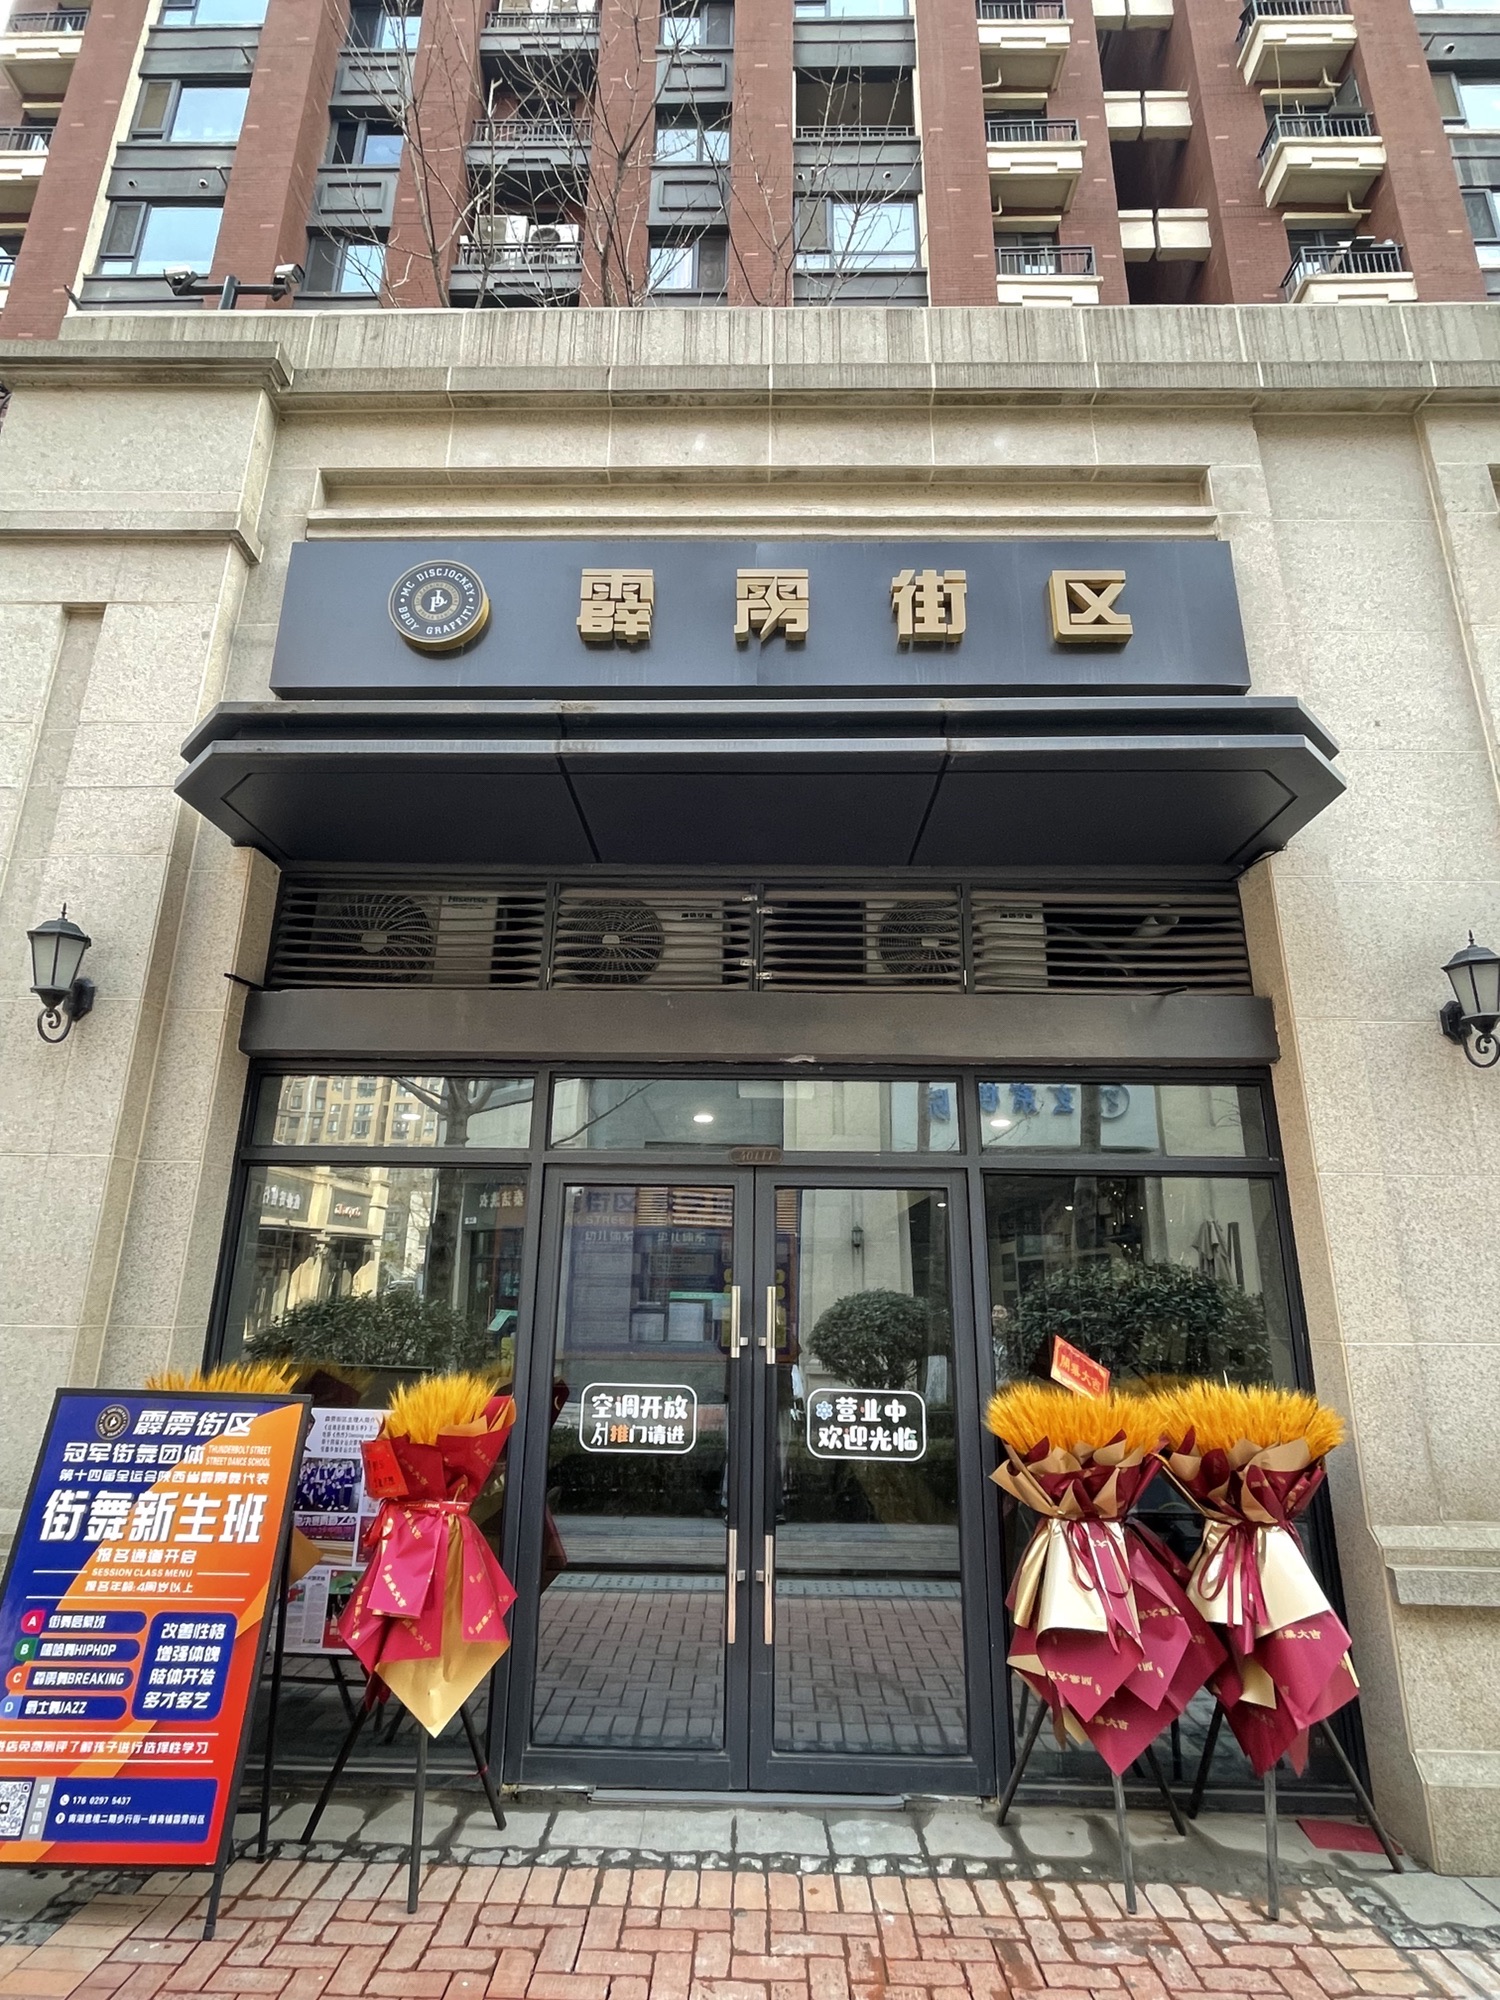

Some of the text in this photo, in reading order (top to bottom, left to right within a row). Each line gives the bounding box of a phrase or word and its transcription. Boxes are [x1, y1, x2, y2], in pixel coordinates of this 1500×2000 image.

[400, 581, 415, 598] MC
[416, 568, 475, 597] DISCJOCKEY
[576, 568, 1133, 650] 霹雳街区
[398, 604, 474, 635] BBOY GRAFFITI
[590, 1394, 689, 1421] 空调开放
[835, 1396, 907, 1424] 营业中
[133, 1410, 258, 1437] 霹雳街区
[609, 1424, 685, 1445] 推门请进
[818, 1426, 918, 1453] 欢迎光临
[62, 1442, 206, 1464] 冠军街舞团体
[208, 1444, 272, 1455] THUNDERBOLT STREET
[205, 1456, 271, 1468] STREET DANCE SCHOOL
[58, 1469, 270, 1485] 第十四届全运会陕西省霹雳舞代表
[39, 1489, 269, 1544] 街舞新生班
[96, 1547, 197, 1565] 报名通道开启
[92, 1568, 193, 1578] SESSION CLASS MENU
[27, 1616, 37, 1626] A
[48, 1614, 107, 1629] 街舞启蒙班
[160, 1622, 227, 1640] 改善性格
[20, 1643, 29, 1655] B
[39, 1642, 117, 1658] 嘻哈舞HIPHOP
[155, 1644, 222, 1663] 增强体魄
[12, 1672, 22, 1683] C
[32, 1671, 125, 1686] 霹雳舞BREAKING
[148, 1667, 216, 1686] 肢体开发
[4, 1701, 14, 1713] D
[24, 1699, 88, 1715] 爵士舞JAZZ
[142, 1690, 212, 1709] 多才多艺
[72, 1796, 132, 1806] 176 0297 5437
